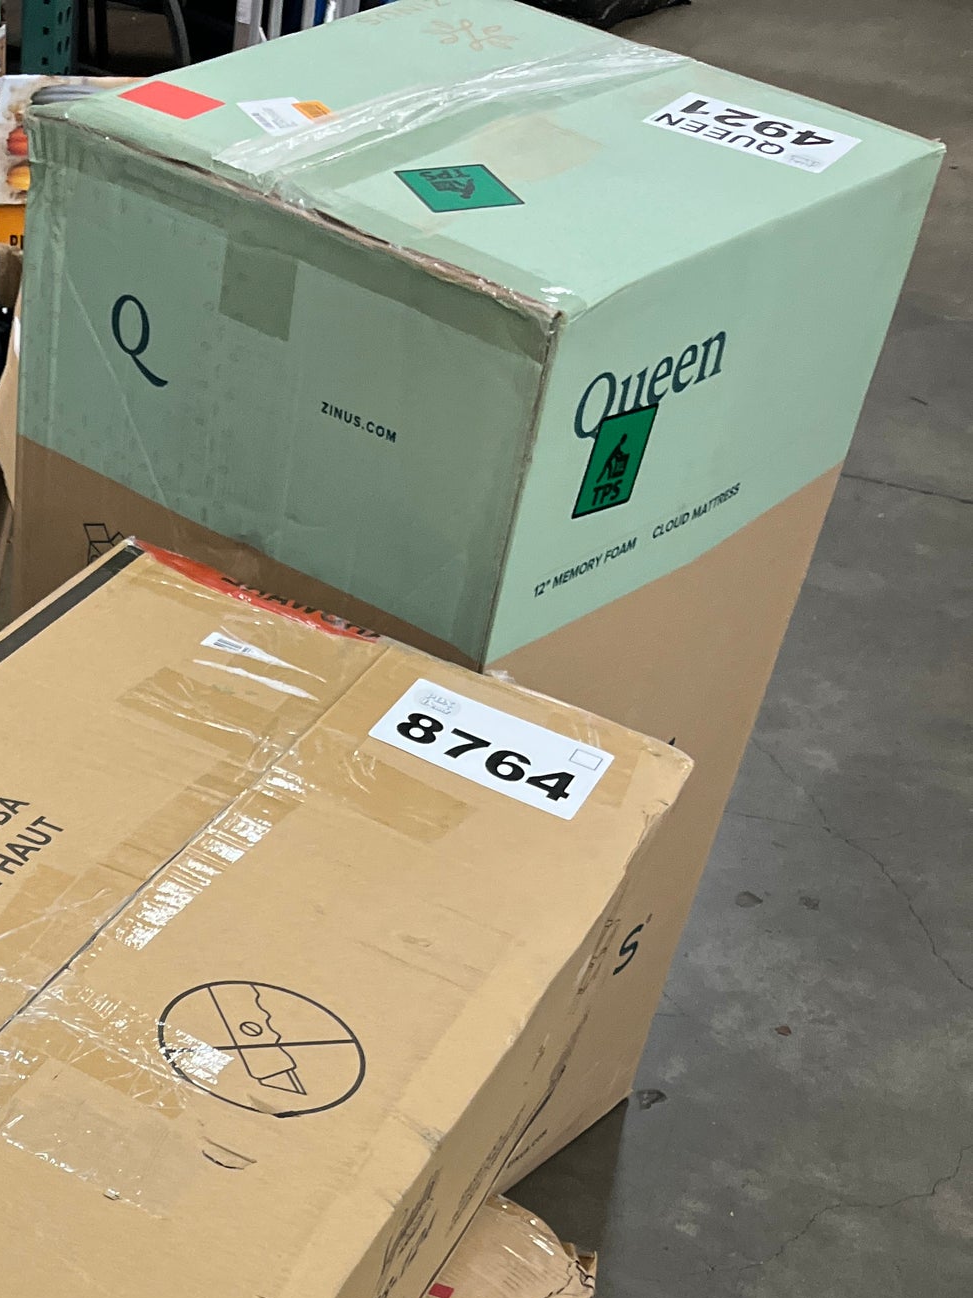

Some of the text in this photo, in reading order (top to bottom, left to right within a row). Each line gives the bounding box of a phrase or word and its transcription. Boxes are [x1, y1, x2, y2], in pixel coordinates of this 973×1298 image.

[654, 113, 785, 155] QUEEN
[680, 100, 834, 146] 4921
[418, 168, 471, 181] TPS
[112, 294, 169, 388] Q
[574, 331, 726, 440] Queen
[321, 401, 397, 443] ZINUS.COM
[591, 479, 623, 506] TPS
[552, 553, 604, 589] MEMORY
[603, 537, 637, 564] FOAM
[652, 512, 690, 539] CLOUD
[691, 482, 742, 521] MATTRESS
[396, 712, 575, 801] 8764
